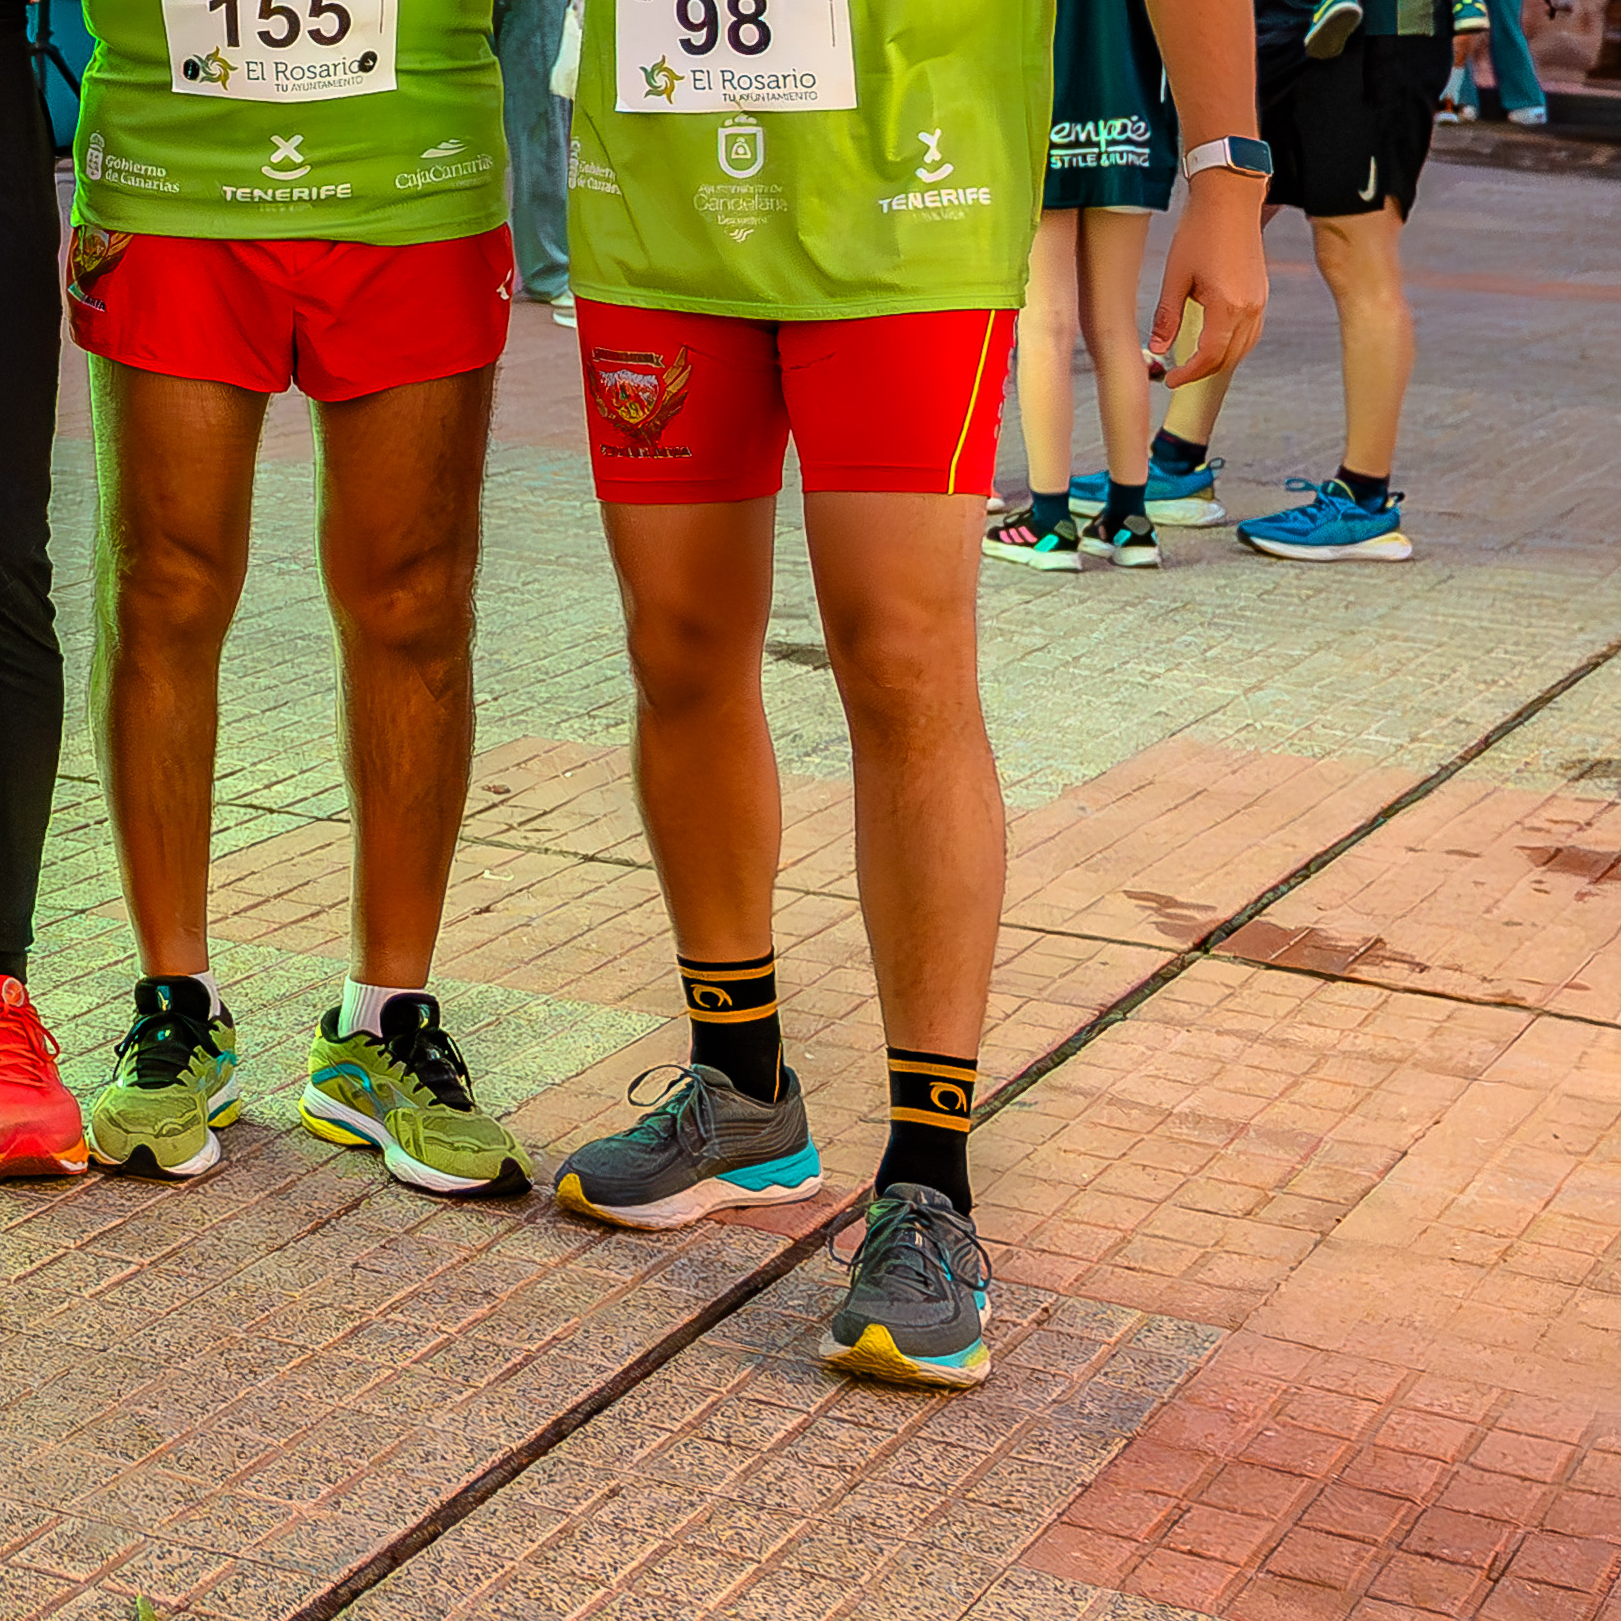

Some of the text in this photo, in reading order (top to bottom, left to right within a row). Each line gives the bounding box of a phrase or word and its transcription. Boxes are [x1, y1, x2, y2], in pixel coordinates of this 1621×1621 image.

[246, 61, 265, 80] El
[690, 68, 816, 90] El Rosario
[275, 83, 288, 92] TU
[723, 93, 735, 102] TU
[105, 154, 168, 178] Gobierno
[395, 153, 494, 191] CajaCanarias
[221, 182, 352, 203] TENERIFE
[878, 187, 991, 214] TENERIFE
